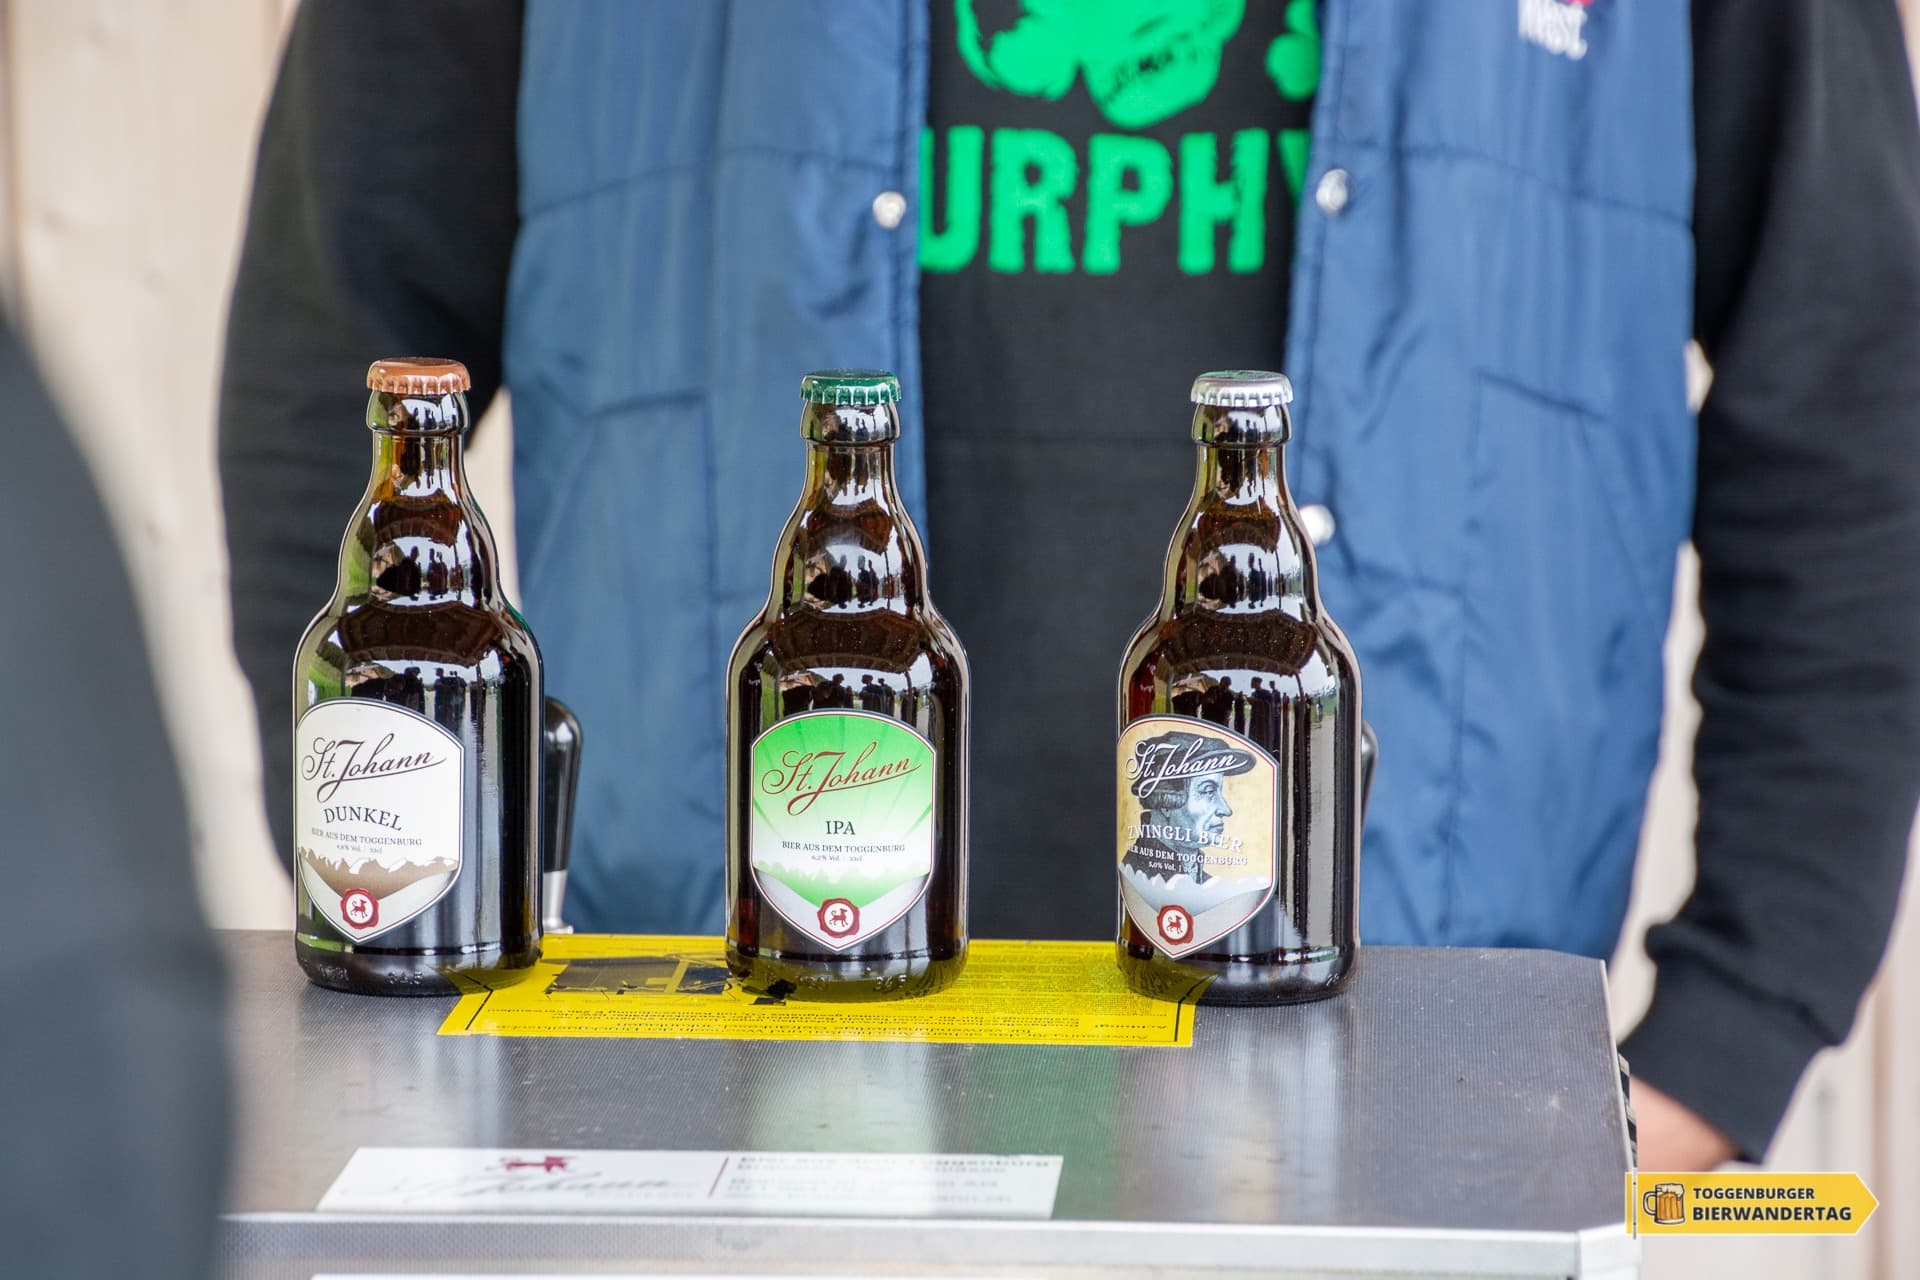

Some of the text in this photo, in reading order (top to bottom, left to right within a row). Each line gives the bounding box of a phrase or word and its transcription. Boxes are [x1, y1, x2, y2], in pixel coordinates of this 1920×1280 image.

[316, 733, 448, 803] Johann
[787, 741, 922, 816] Johann
[1138, 738, 1248, 799] Johann
[324, 805, 402, 831] DUNKEL
[825, 820, 856, 836] IPA
[325, 831, 339, 840] AUS
[340, 833, 357, 843] DEM
[360, 836, 422, 846] TOGGENBURG
[782, 840, 905, 854] BIER AUS DEM TOGGENBURG
[1127, 824, 1243, 852] ZWINGLI BIER
[1139, 846, 1154, 858] AUS
[1156, 849, 1175, 861] DEM
[1177, 853, 1248, 866] TOGGENBURG
